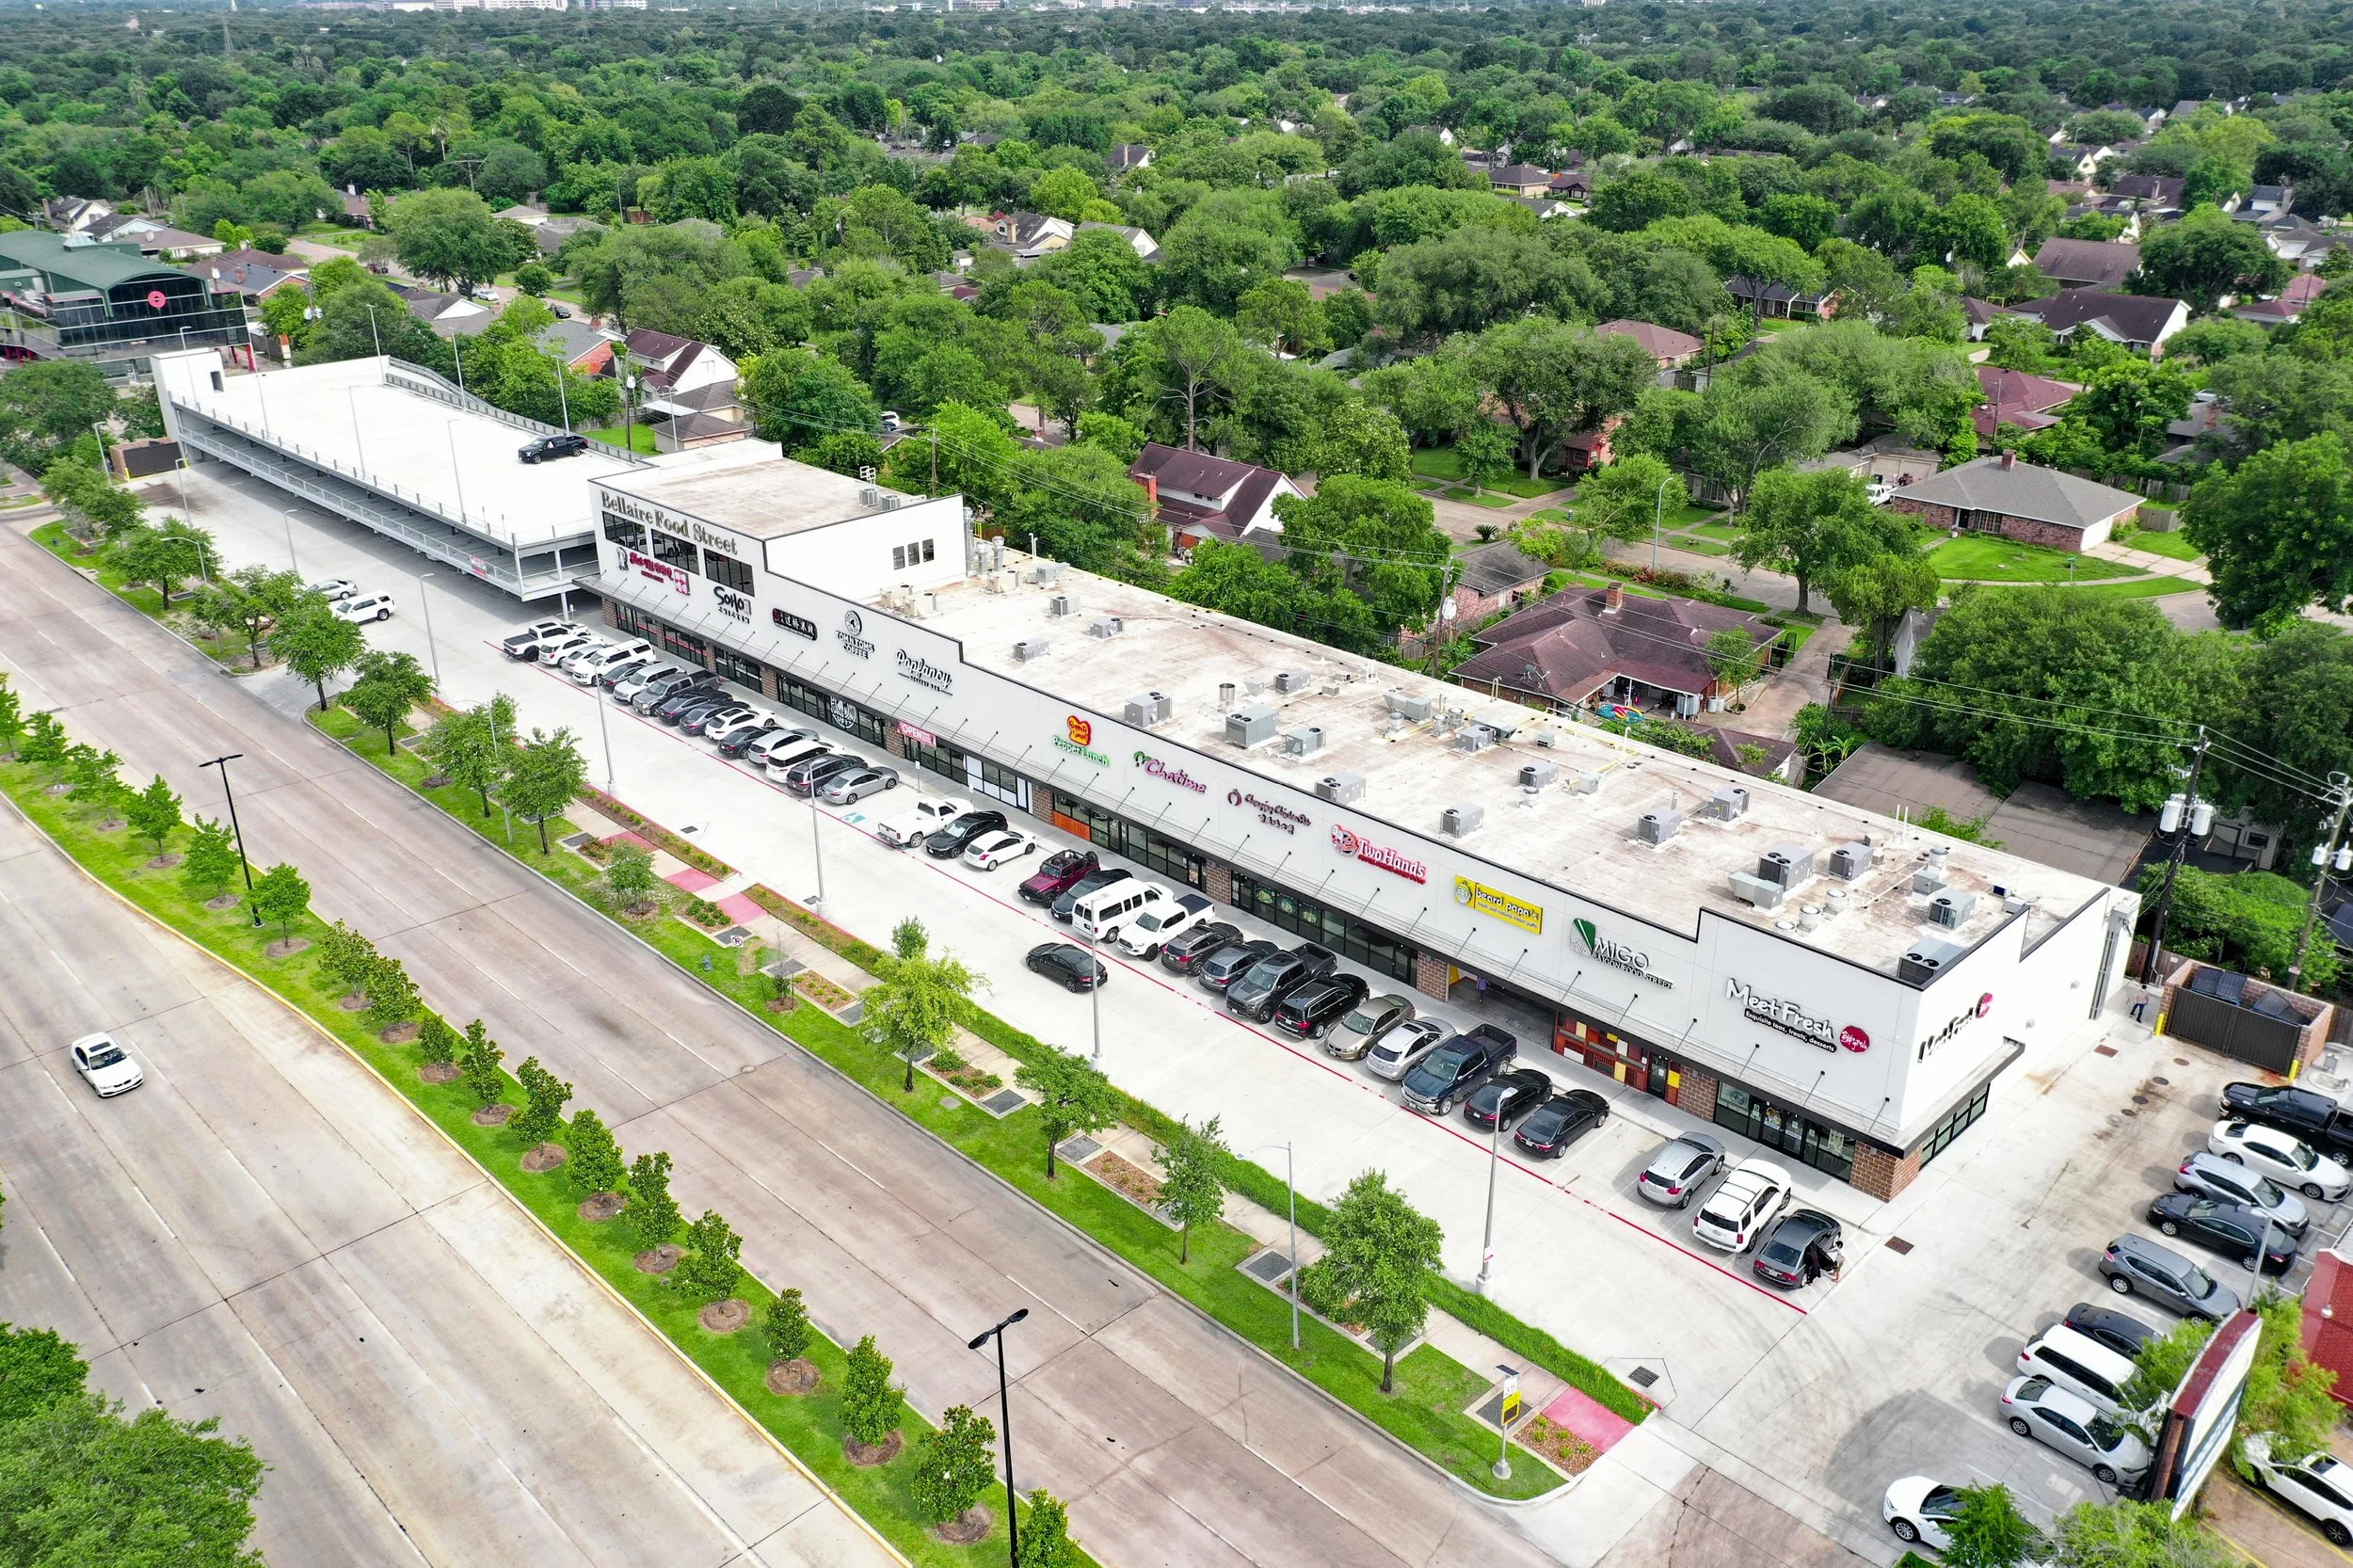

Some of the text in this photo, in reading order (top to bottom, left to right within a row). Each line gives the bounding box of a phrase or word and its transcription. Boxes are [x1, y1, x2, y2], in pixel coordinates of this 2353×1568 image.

[600, 490, 738, 555] Bellaire Food Street
[842, 642, 869, 660] COFFEE
[902, 724, 922, 739] OPEN
[1052, 734, 1111, 767] Pepper Lunch
[1144, 759, 1207, 794] Chatime
[1358, 837, 1384, 861] Two
[1384, 847, 1426, 878] Hands
[1475, 888, 1540, 921] beard papa's
[1594, 936, 1650, 969] MIGO
[1593, 952, 1673, 990] SAIGON FOOD STREET
[1726, 978, 1834, 1040] Meet Fresh
[1745, 1010, 1772, 1027] Exquisite
[1809, 1036, 1834, 1052] desserts
